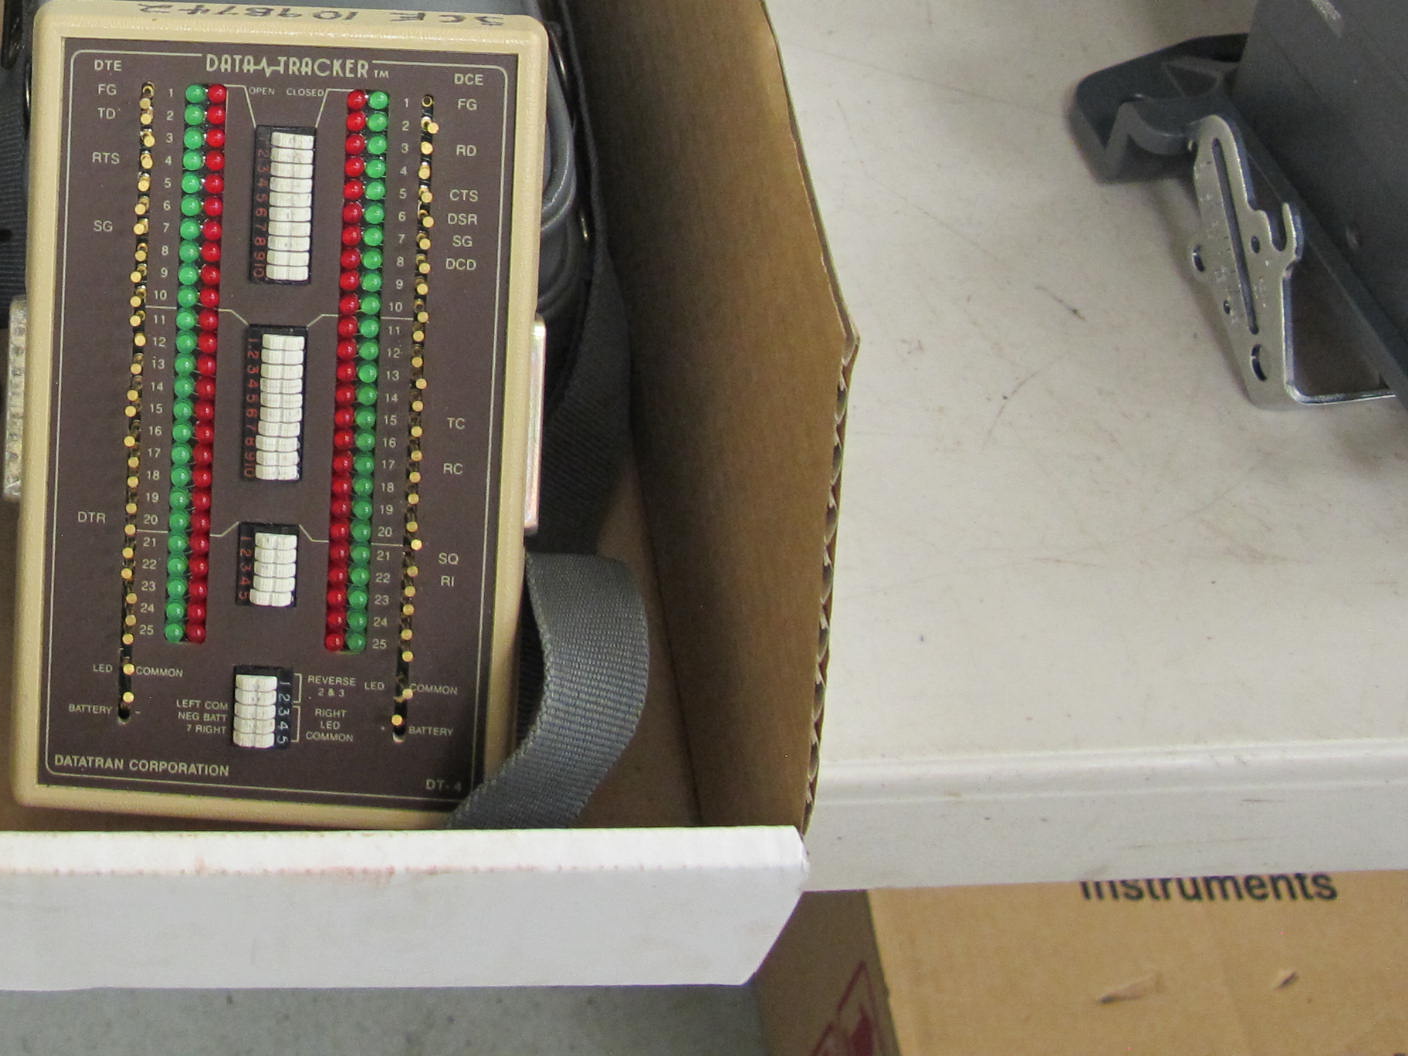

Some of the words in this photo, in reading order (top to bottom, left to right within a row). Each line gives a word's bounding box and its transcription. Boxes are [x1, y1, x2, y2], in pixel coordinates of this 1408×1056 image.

[95, 60, 121, 71] DTE
[205, 55, 254, 73] DATA
[277, 56, 369, 78] TRACKER
[455, 74, 483, 85] DCE
[98, 84, 116, 95] FG
[249, 87, 274, 95] OPEN
[286, 88, 324, 97] CLOSED
[458, 99, 477, 110] FG
[98, 108, 115, 119] TD
[167, 111, 173, 120] 2
[402, 121, 409, 131] 2
[167, 133, 173, 143] 3
[402, 143, 408, 153] 3
[457, 145, 476, 156] RD
[92, 152, 119, 164] RTS
[165, 156, 171, 165] 4
[400, 167, 407, 175] 4
[165, 178, 171, 188] 5
[400, 188, 407, 199] 5
[450, 190, 478, 201] CTS
[164, 200, 170, 210] 6
[399, 212, 405, 221] 6
[448, 213, 477, 225] DSR
[94, 220, 112, 232] SG
[163, 223, 169, 232] 7
[399, 234, 405, 243] 7
[453, 235, 472, 247] SG
[162, 246, 168, 255] 8
[397, 256, 404, 267] 8
[446, 258, 476, 270] DCD
[161, 267, 168, 277] 9
[396, 279, 403, 289] 9
[155, 290, 167, 300] 10
[390, 302, 402, 312] 10
[154, 315, 164, 324] 11
[389, 326, 399, 335] 11
[153, 337, 166, 347] 12
[388, 348, 400, 358] 12
[153, 359, 165, 369] 13
[387, 370, 399, 381] 13
[152, 382, 163, 391] 14
[387, 394, 398, 402] 14
[151, 404, 162, 413] 15
[385, 415, 396, 425] 15
[448, 418, 464, 429] TC
[150, 426, 162, 436] 16
[384, 437, 396, 448] 16
[148, 448, 160, 458] 17
[383, 460, 395, 469] 17
[443, 463, 463, 474] RC
[148, 470, 159, 480] 18
[382, 482, 394, 492] 18
[147, 492, 159, 502] 19
[381, 505, 393, 515] 19
[78, 512, 105, 523] DTR
[144, 514, 158, 525] 20
[378, 527, 392, 537] 20
[143, 537, 155, 546] 21
[377, 551, 389, 560] 21
[439, 553, 458, 565] SQ
[142, 559, 157, 569] 22
[376, 573, 390, 583] 22
[441, 576, 454, 586] RI
[142, 581, 155, 591] 23
[374, 594, 389, 605] 23
[141, 603, 154, 613] 24
[374, 617, 387, 627] 24
[140, 625, 153, 635] 25
[373, 639, 386, 649] 25
[93, 664, 112, 672] LED
[136, 666, 183, 677] COMMON
[308, 675, 355, 686] REVERSE
[318, 688, 325, 697] 2
[339, 688, 345, 698] 3
[365, 682, 384, 690] LED
[410, 683, 458, 695] COMMON
[69, 704, 110, 714] BATTERY
[177, 699, 200, 708] LEFT
[205, 701, 227, 710] COM
[178, 712, 199, 720] NEG
[204, 713, 226, 722] BATT
[315, 708, 346, 717] RIGHT
[196, 725, 226, 734] RIGHT
[321, 721, 340, 729] LED
[409, 726, 453, 736] BATTERY
[306, 732, 353, 741] COMMON
[55, 755, 123, 769] DATATRAN
[129, 760, 229, 776] CORPORATION
[1080, 873, 1337, 901] Instruments
